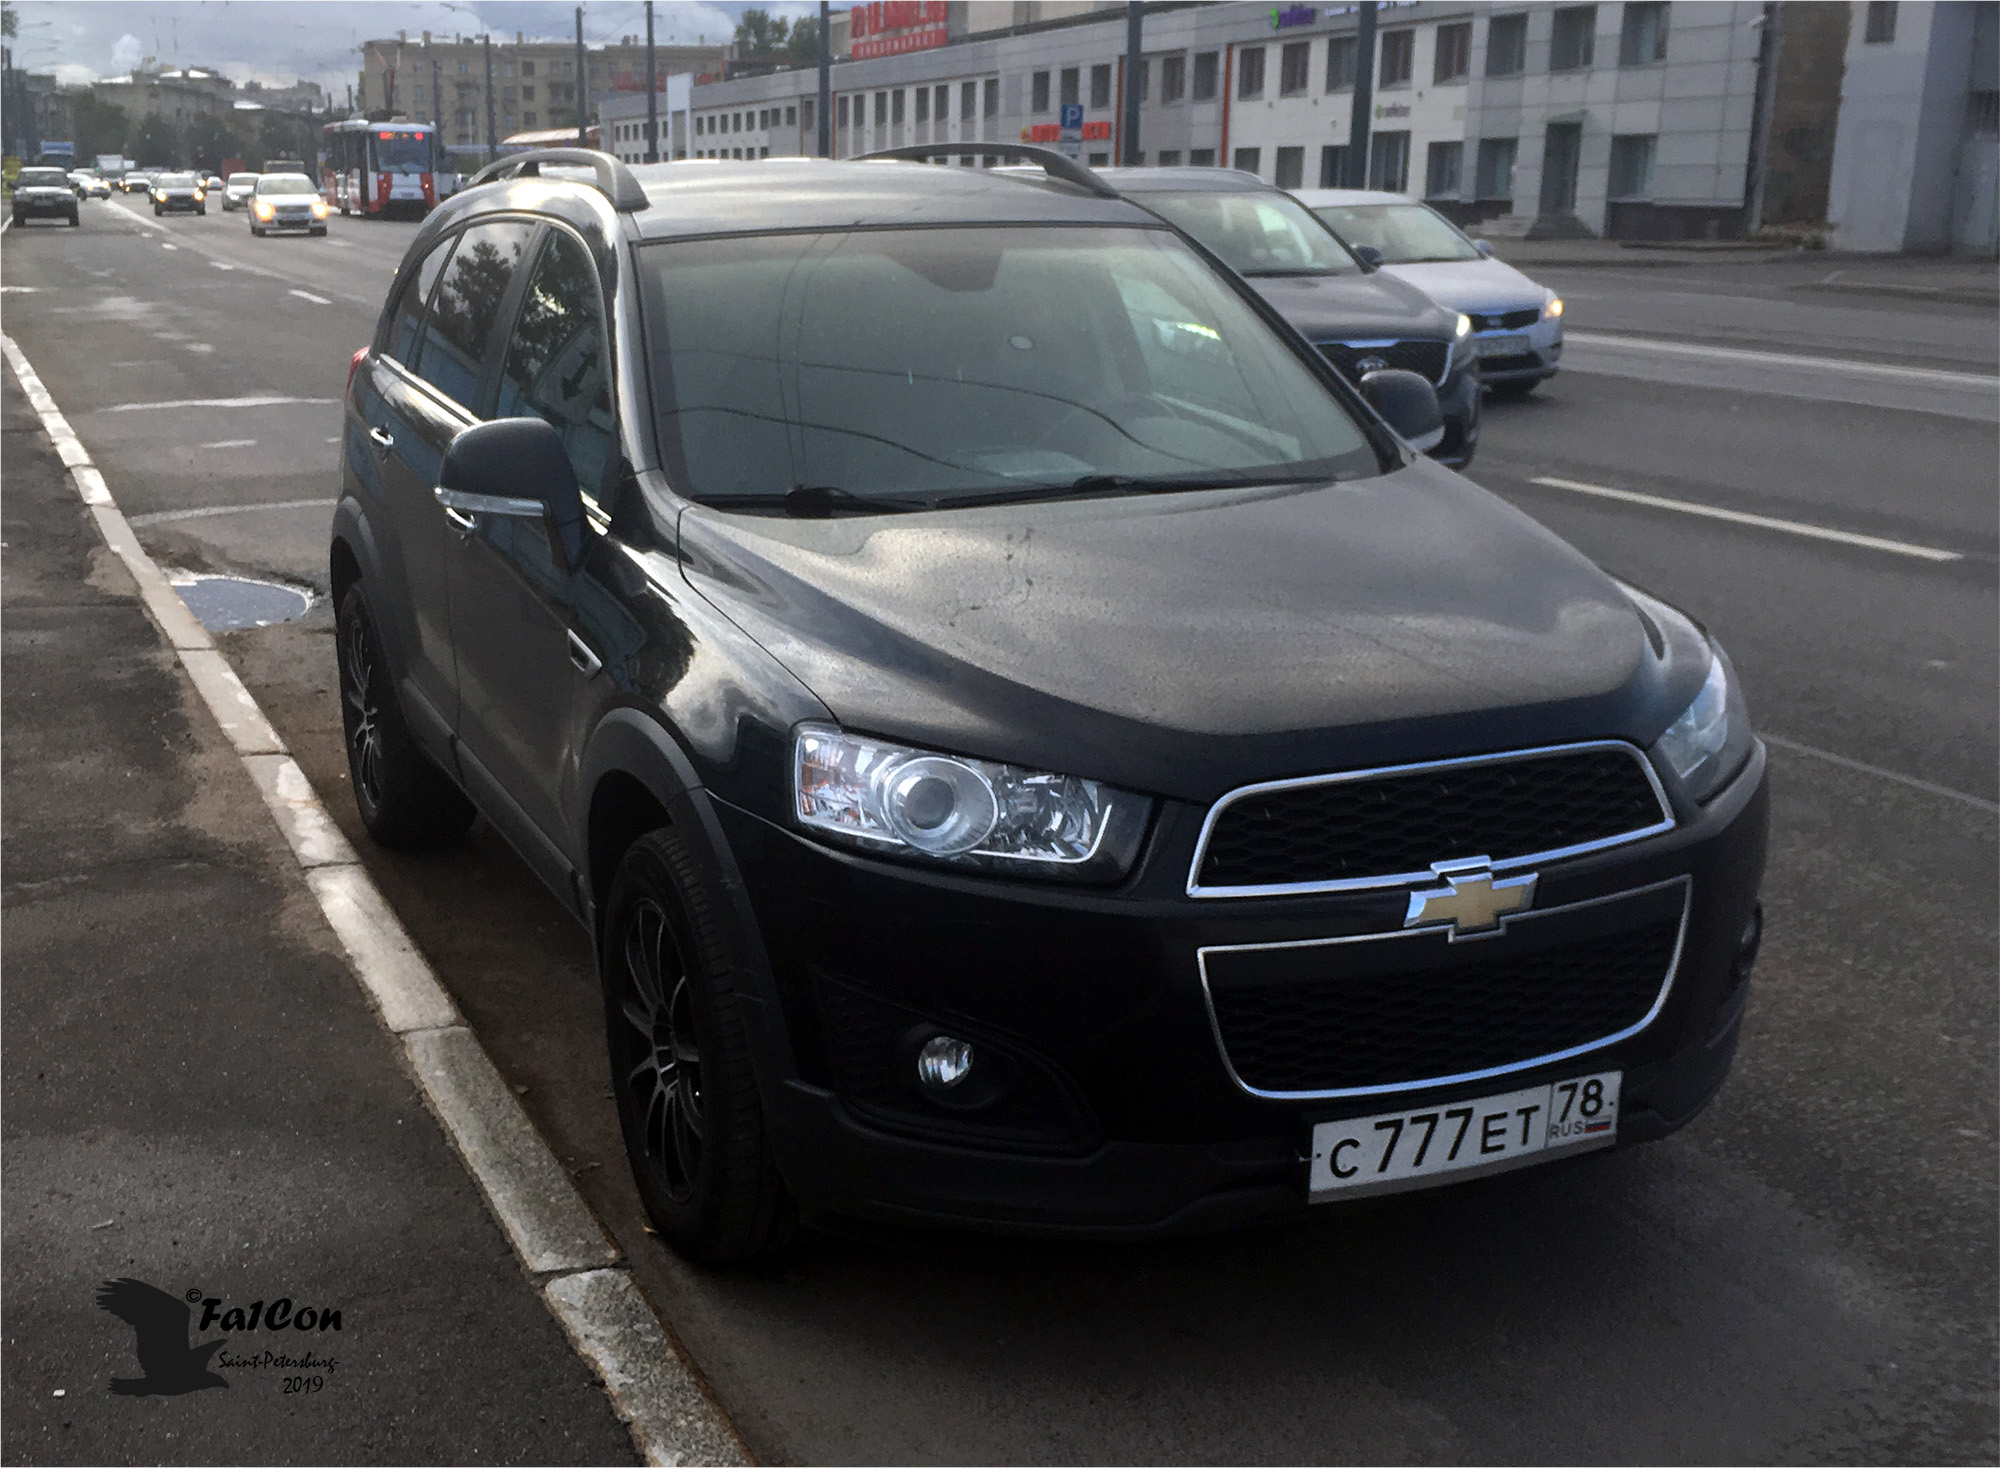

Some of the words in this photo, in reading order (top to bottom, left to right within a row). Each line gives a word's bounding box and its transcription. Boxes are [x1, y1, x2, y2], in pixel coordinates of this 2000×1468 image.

[1066, 107, 1080, 127] P
[1558, 1078, 1605, 1123] 78
[1550, 1121, 1583, 1140] RUS
